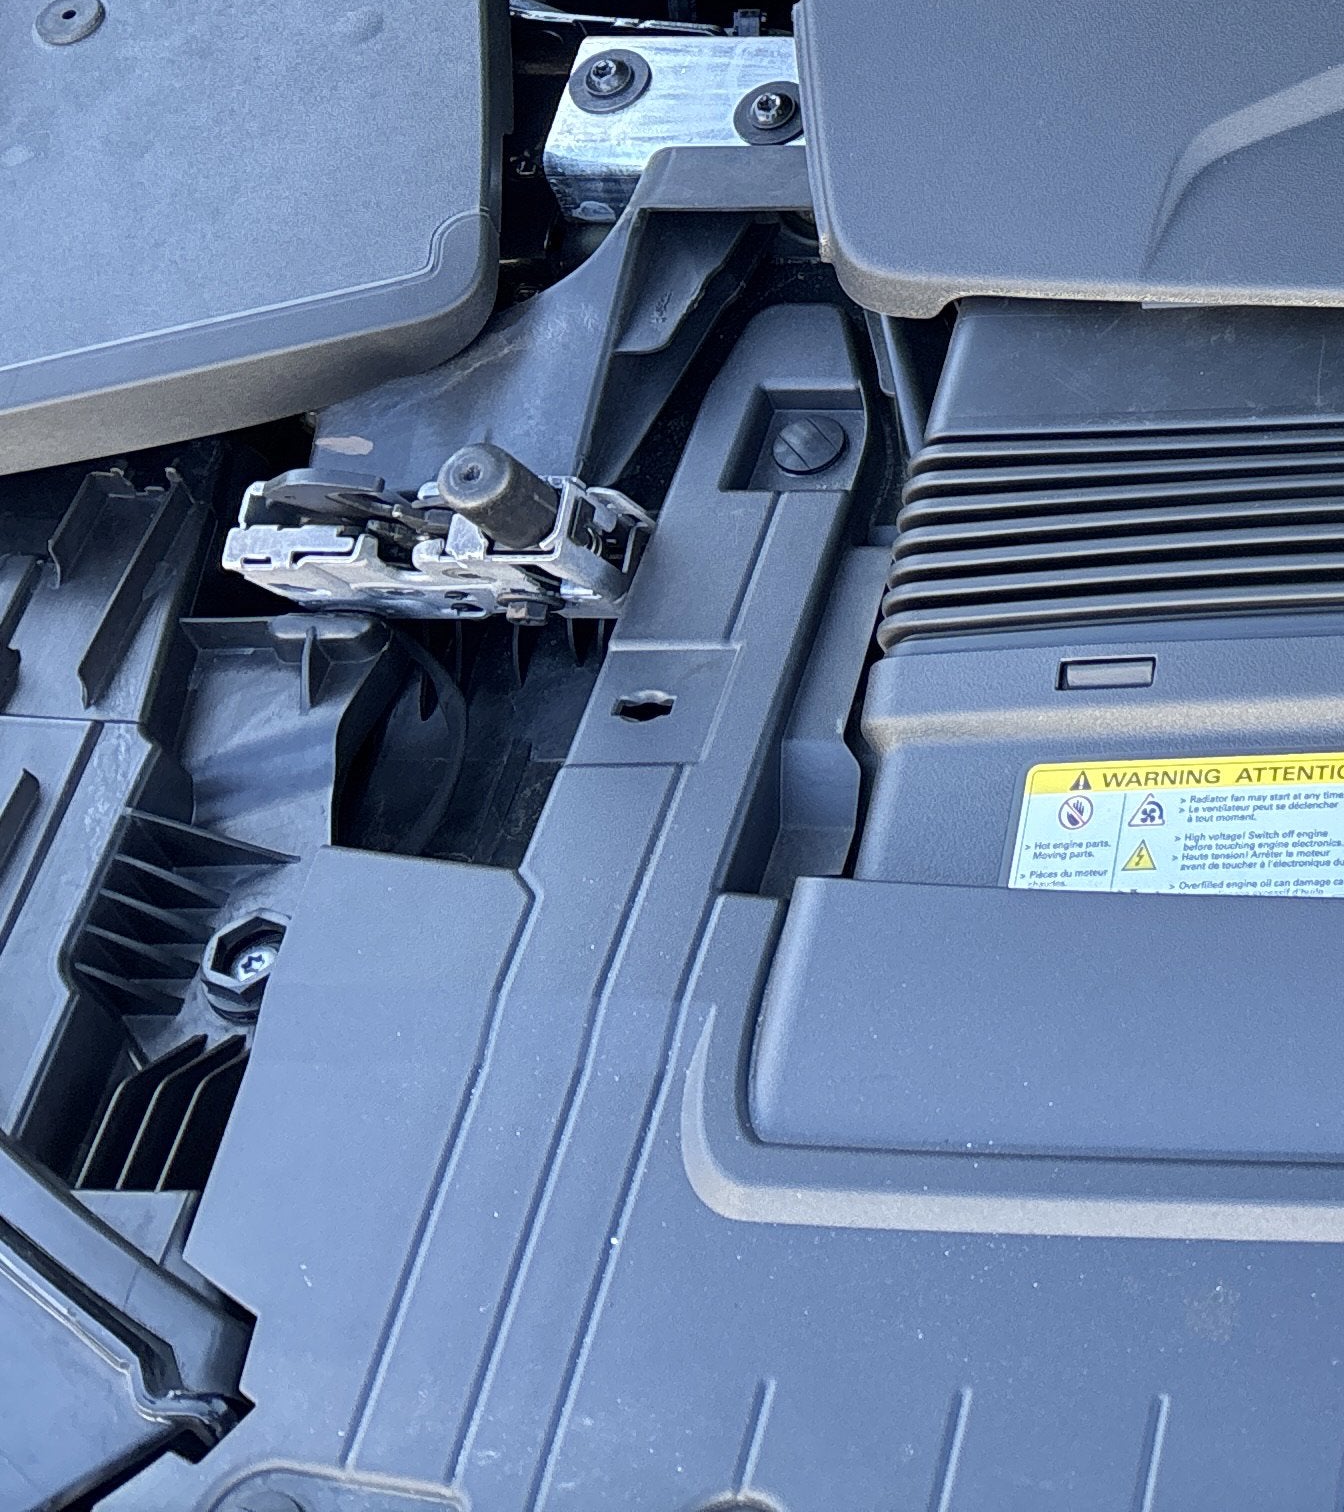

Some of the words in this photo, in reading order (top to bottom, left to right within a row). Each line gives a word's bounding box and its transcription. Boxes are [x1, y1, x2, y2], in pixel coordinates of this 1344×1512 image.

[1102, 768, 1221, 788] WARNING
[1190, 794, 1228, 804] Radiator
[1230, 793, 1246, 802] fan
[1247, 794, 1267, 803] may
[1269, 793, 1291, 801] start
[1292, 792, 1302, 800] at
[1303, 792, 1321, 802] any
[1188, 805, 1200, 814] Le
[1202, 804, 1250, 813] ventilateur
[1252, 803, 1273, 813] peut
[1195, 815, 1214, 823] tout
[1215, 813, 1257, 822] moment.
[1184, 833, 1206, 843] High
[1248, 831, 1280, 839] Switch
[1281, 830, 1295, 839] off
[1296, 829, 1329, 839] engine
[1034, 841, 1051, 850] Hot
[1052, 840, 1083, 850] engine
[1085, 840, 1112, 850] parts.
[1183, 842, 1212, 851] before
[1214, 841, 1255, 851] touching
[1257, 840, 1290, 850] engine
[1032, 851, 1068, 861] Moving
[1069, 850, 1095, 861] parts.
[1296, 849, 1331, 858] moteur
[1208, 862, 1220, 870] de
[1221, 861, 1257, 870] toucher
[1060, 869, 1073, 878] du
[1074, 869, 1108, 877] moteur
[1179, 881, 1224, 890] Overfilled
[1225, 880, 1257, 890] engine
[1259, 879, 1272, 888] oil
[1273, 879, 1291, 888] can
[1292, 878, 1331, 888] damage
